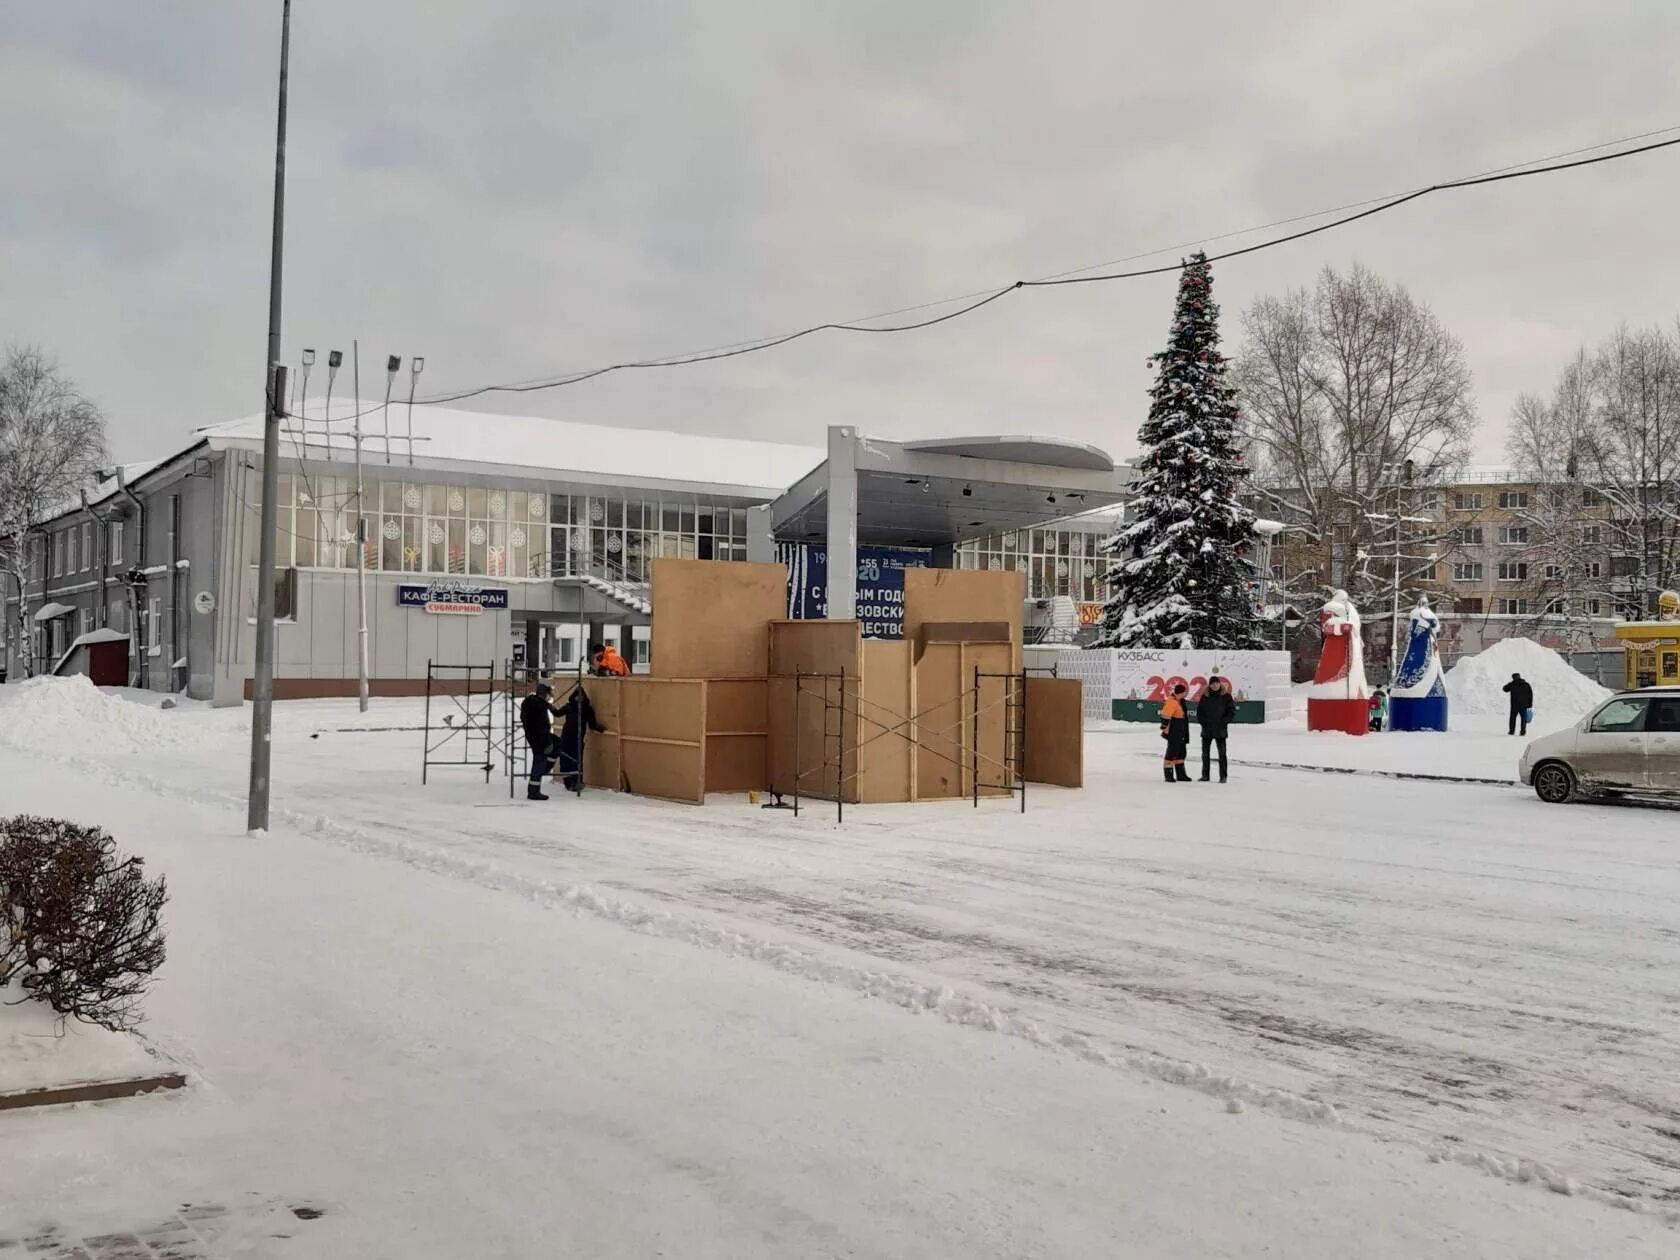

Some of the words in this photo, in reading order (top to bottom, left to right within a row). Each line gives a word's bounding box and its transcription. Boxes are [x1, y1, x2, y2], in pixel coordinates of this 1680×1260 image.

[857, 566, 880, 581] 20
[404, 591, 504, 604] КАФЕ-РЕСТОРАН
[812, 586, 821, 599] С
[877, 589, 905, 603] ГОД
[428, 604, 481, 613] СУБМАРИНА
[1117, 651, 1165, 662] КУЗБАСС
